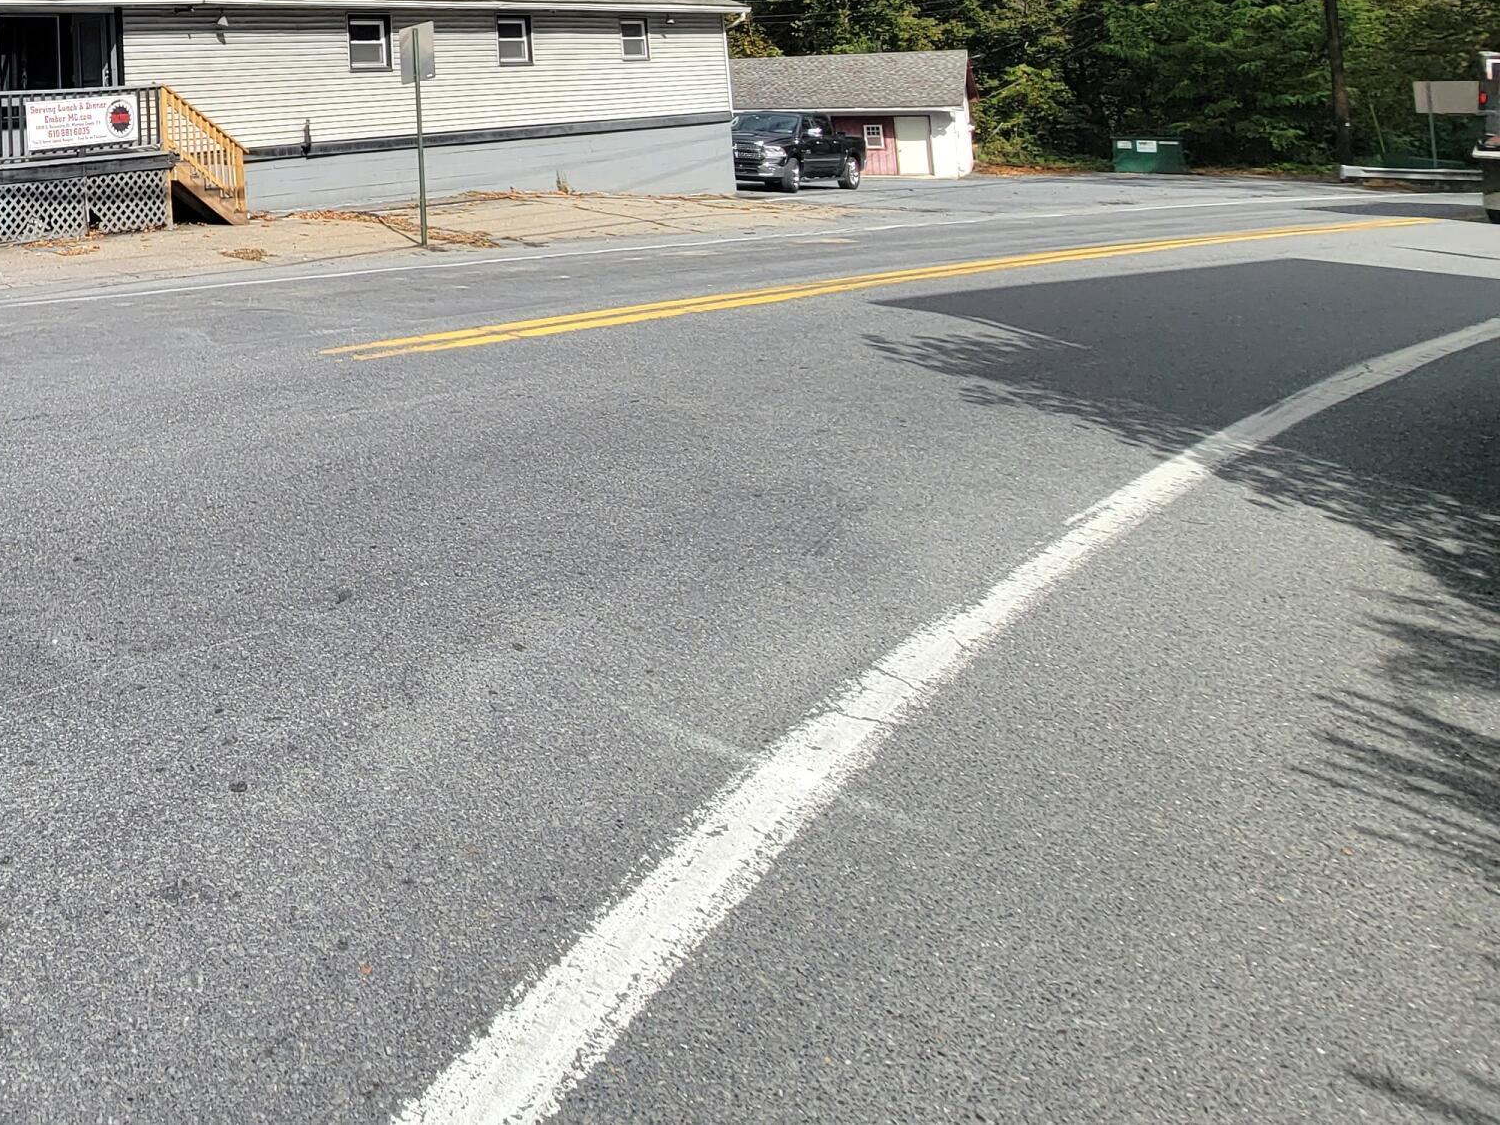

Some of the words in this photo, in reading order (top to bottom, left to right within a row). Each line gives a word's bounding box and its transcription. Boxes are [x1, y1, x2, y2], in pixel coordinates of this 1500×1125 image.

[30, 106, 56, 115] Serving
[57, 104, 78, 112] Lunch
[85, 101, 107, 110] Dinner
[44, 115, 66, 124] Ember
